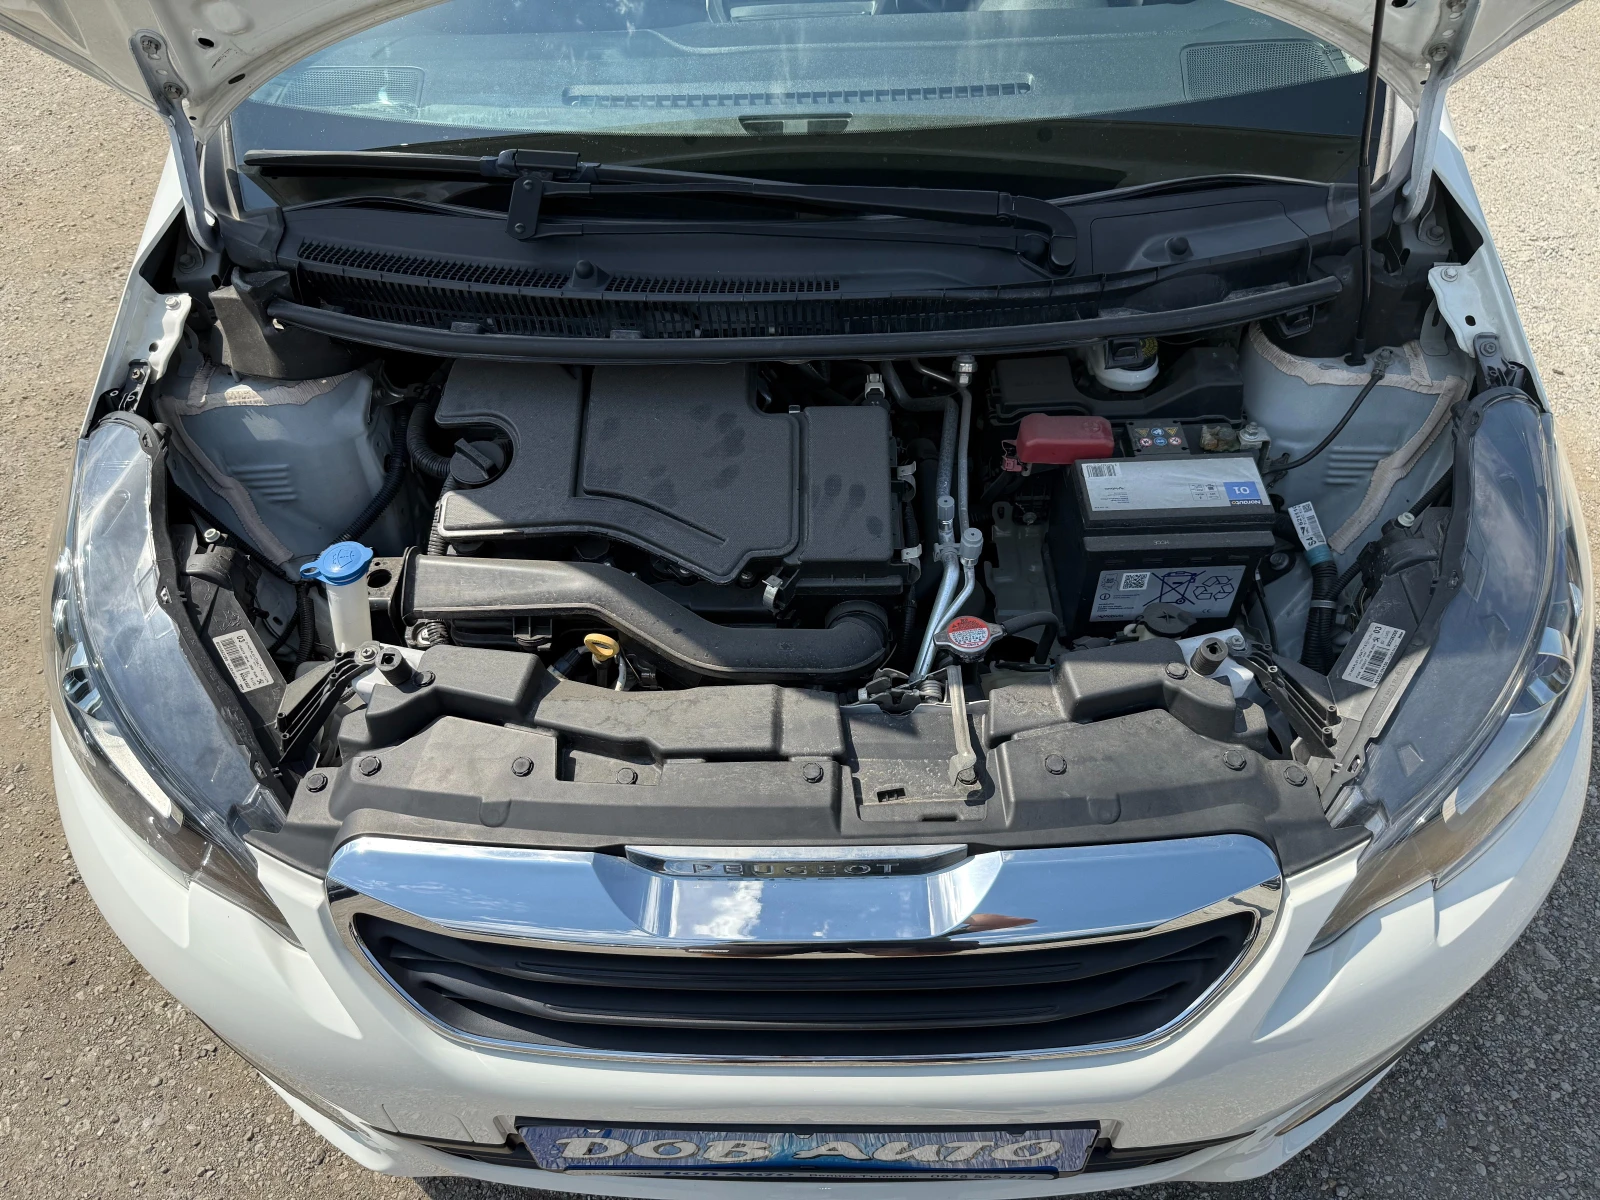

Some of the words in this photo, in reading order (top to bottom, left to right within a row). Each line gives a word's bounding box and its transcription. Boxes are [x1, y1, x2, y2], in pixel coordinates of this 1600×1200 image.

[1233, 486, 1250, 494] 01
[692, 863, 899, 874] PEUGEOT
[557, 1138, 772, 1162] DOB
[793, 1138, 1061, 1162] AUTO
